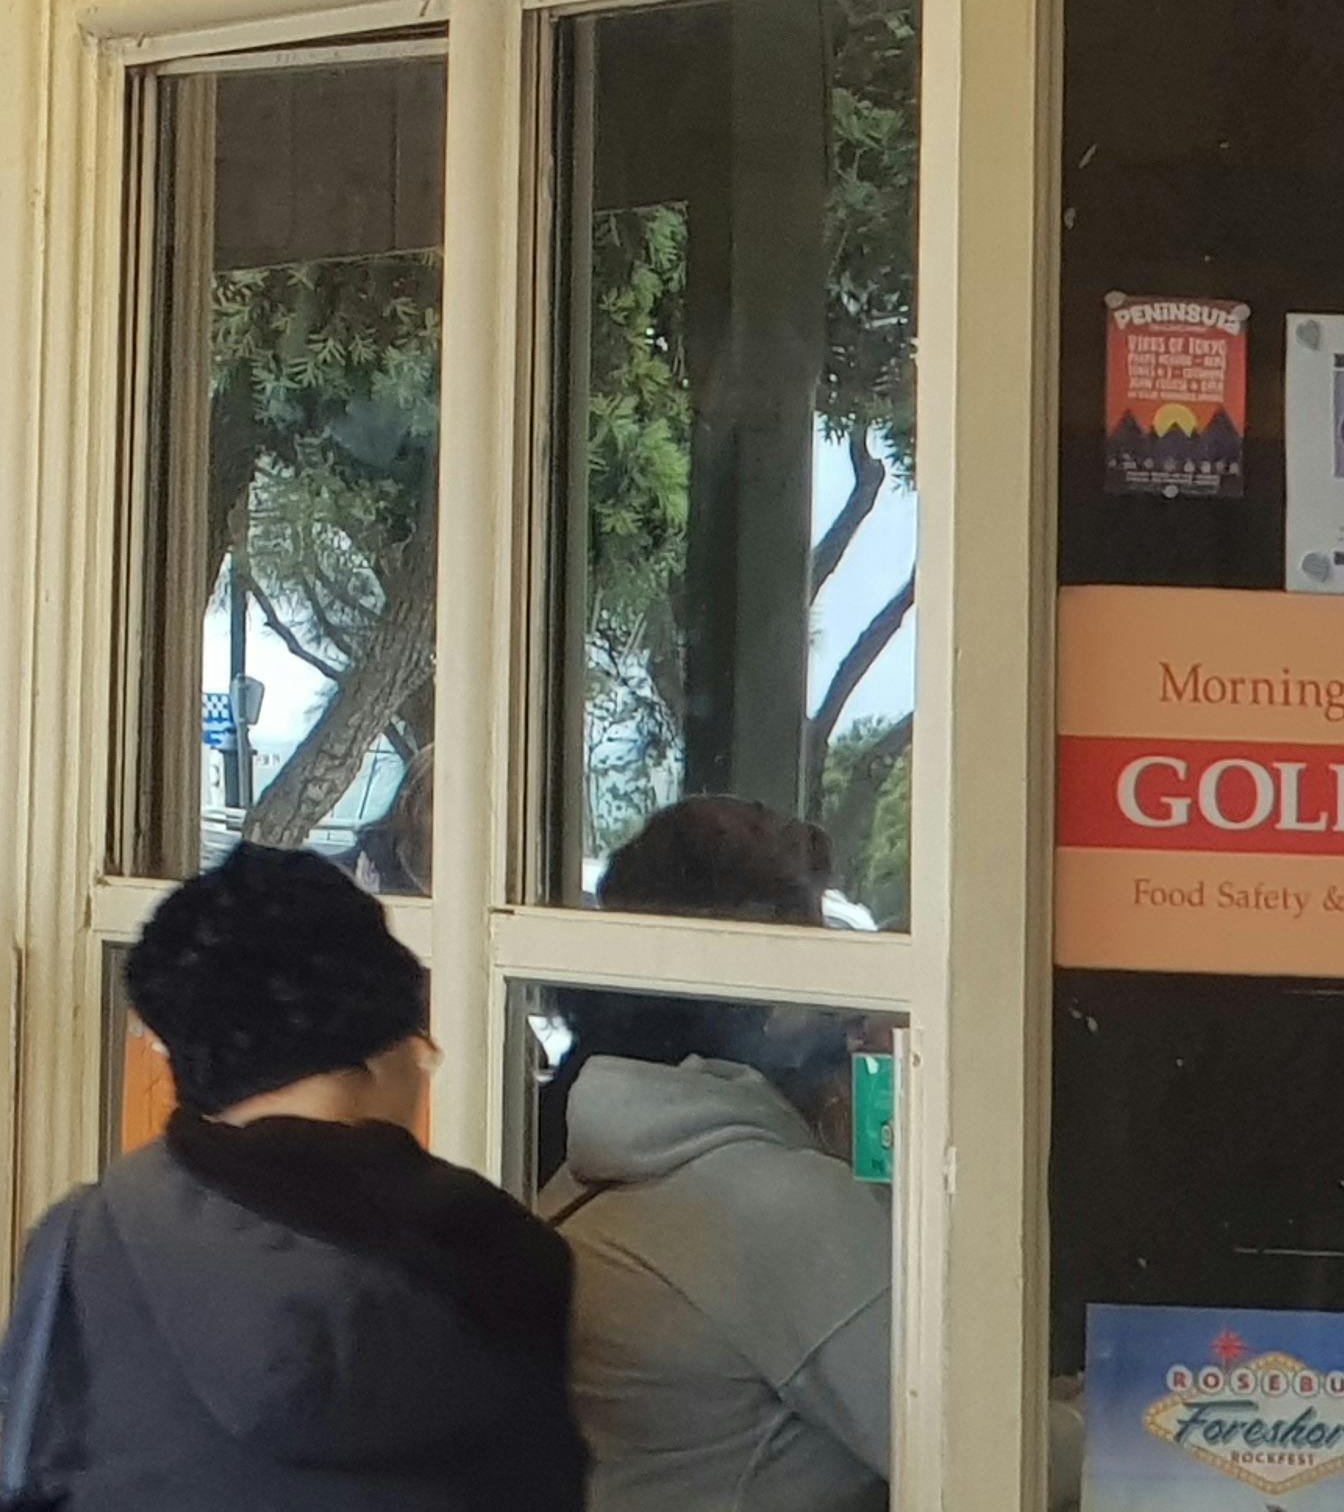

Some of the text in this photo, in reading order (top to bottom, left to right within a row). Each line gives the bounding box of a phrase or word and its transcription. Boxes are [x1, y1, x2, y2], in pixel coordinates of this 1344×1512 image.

[1116, 755, 1344, 832] GOL
[1132, 878, 1206, 908] Food
[1216, 881, 1311, 920] Safety
[1230, 1450, 1315, 1467] ROCKFEST
